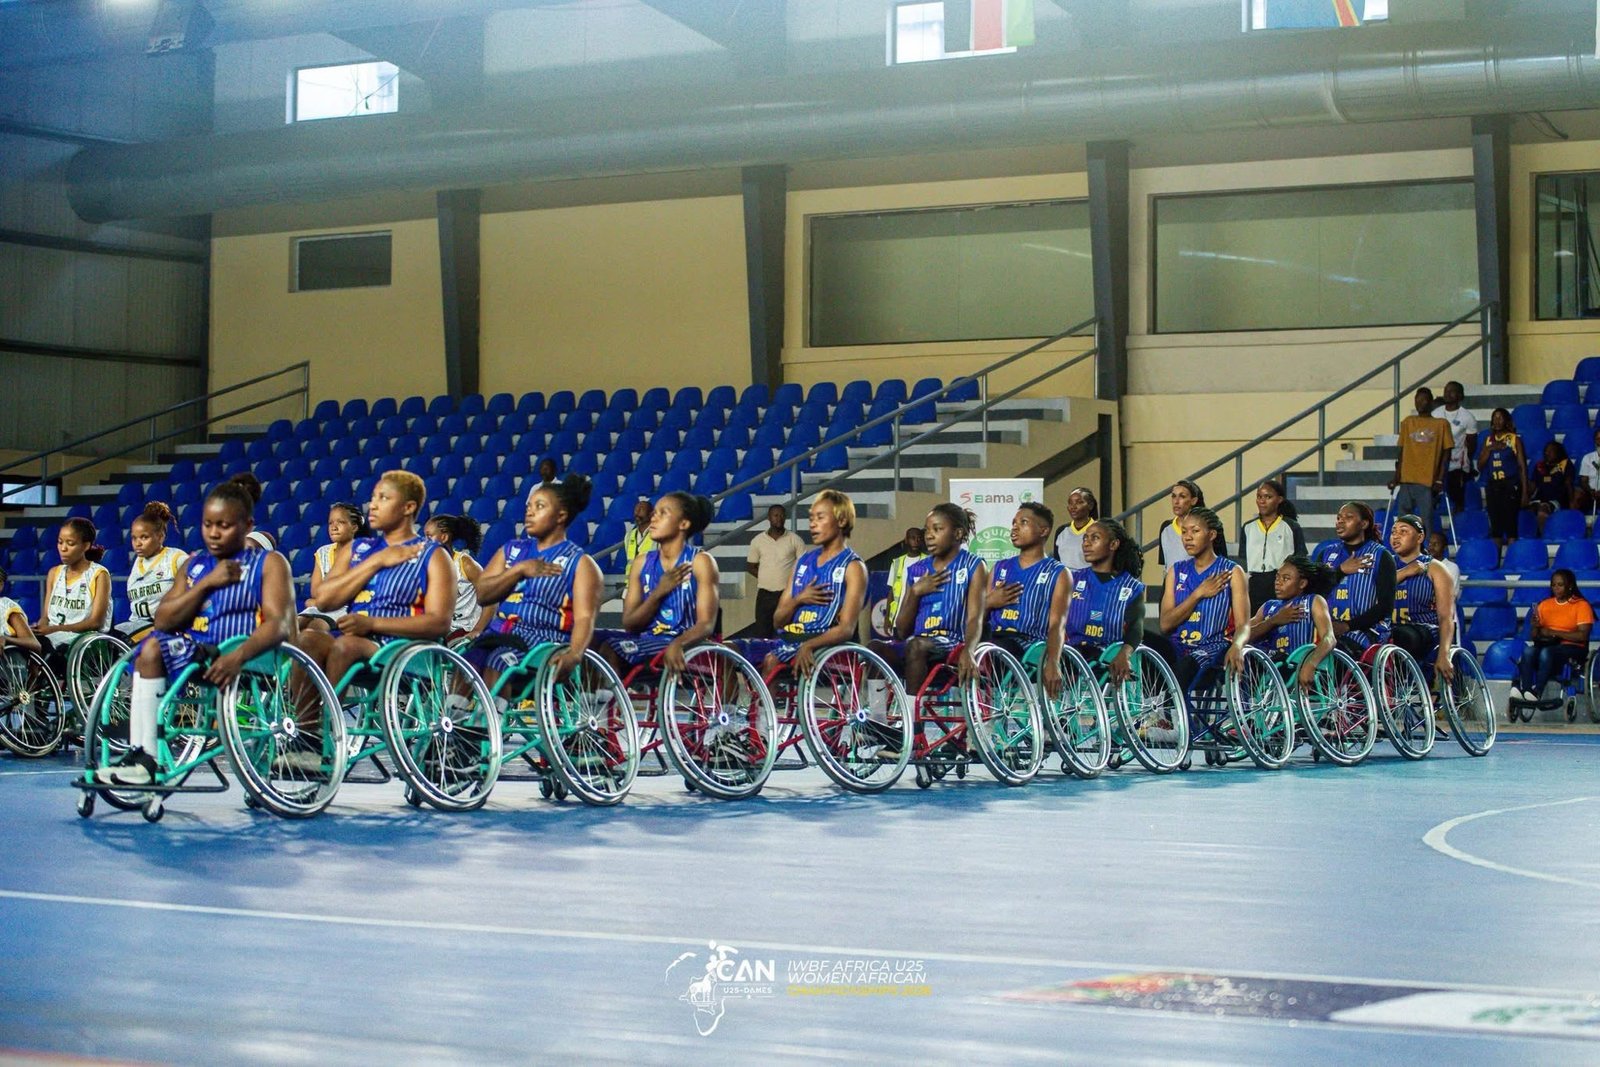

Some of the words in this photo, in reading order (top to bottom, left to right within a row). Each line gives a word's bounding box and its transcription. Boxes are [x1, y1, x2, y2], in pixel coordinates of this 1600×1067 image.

[977, 528, 1010, 543] EQUIP
[134, 601, 151, 618] 10
[1001, 608, 1020, 621] RDC
[1084, 624, 1104, 638] RDC
